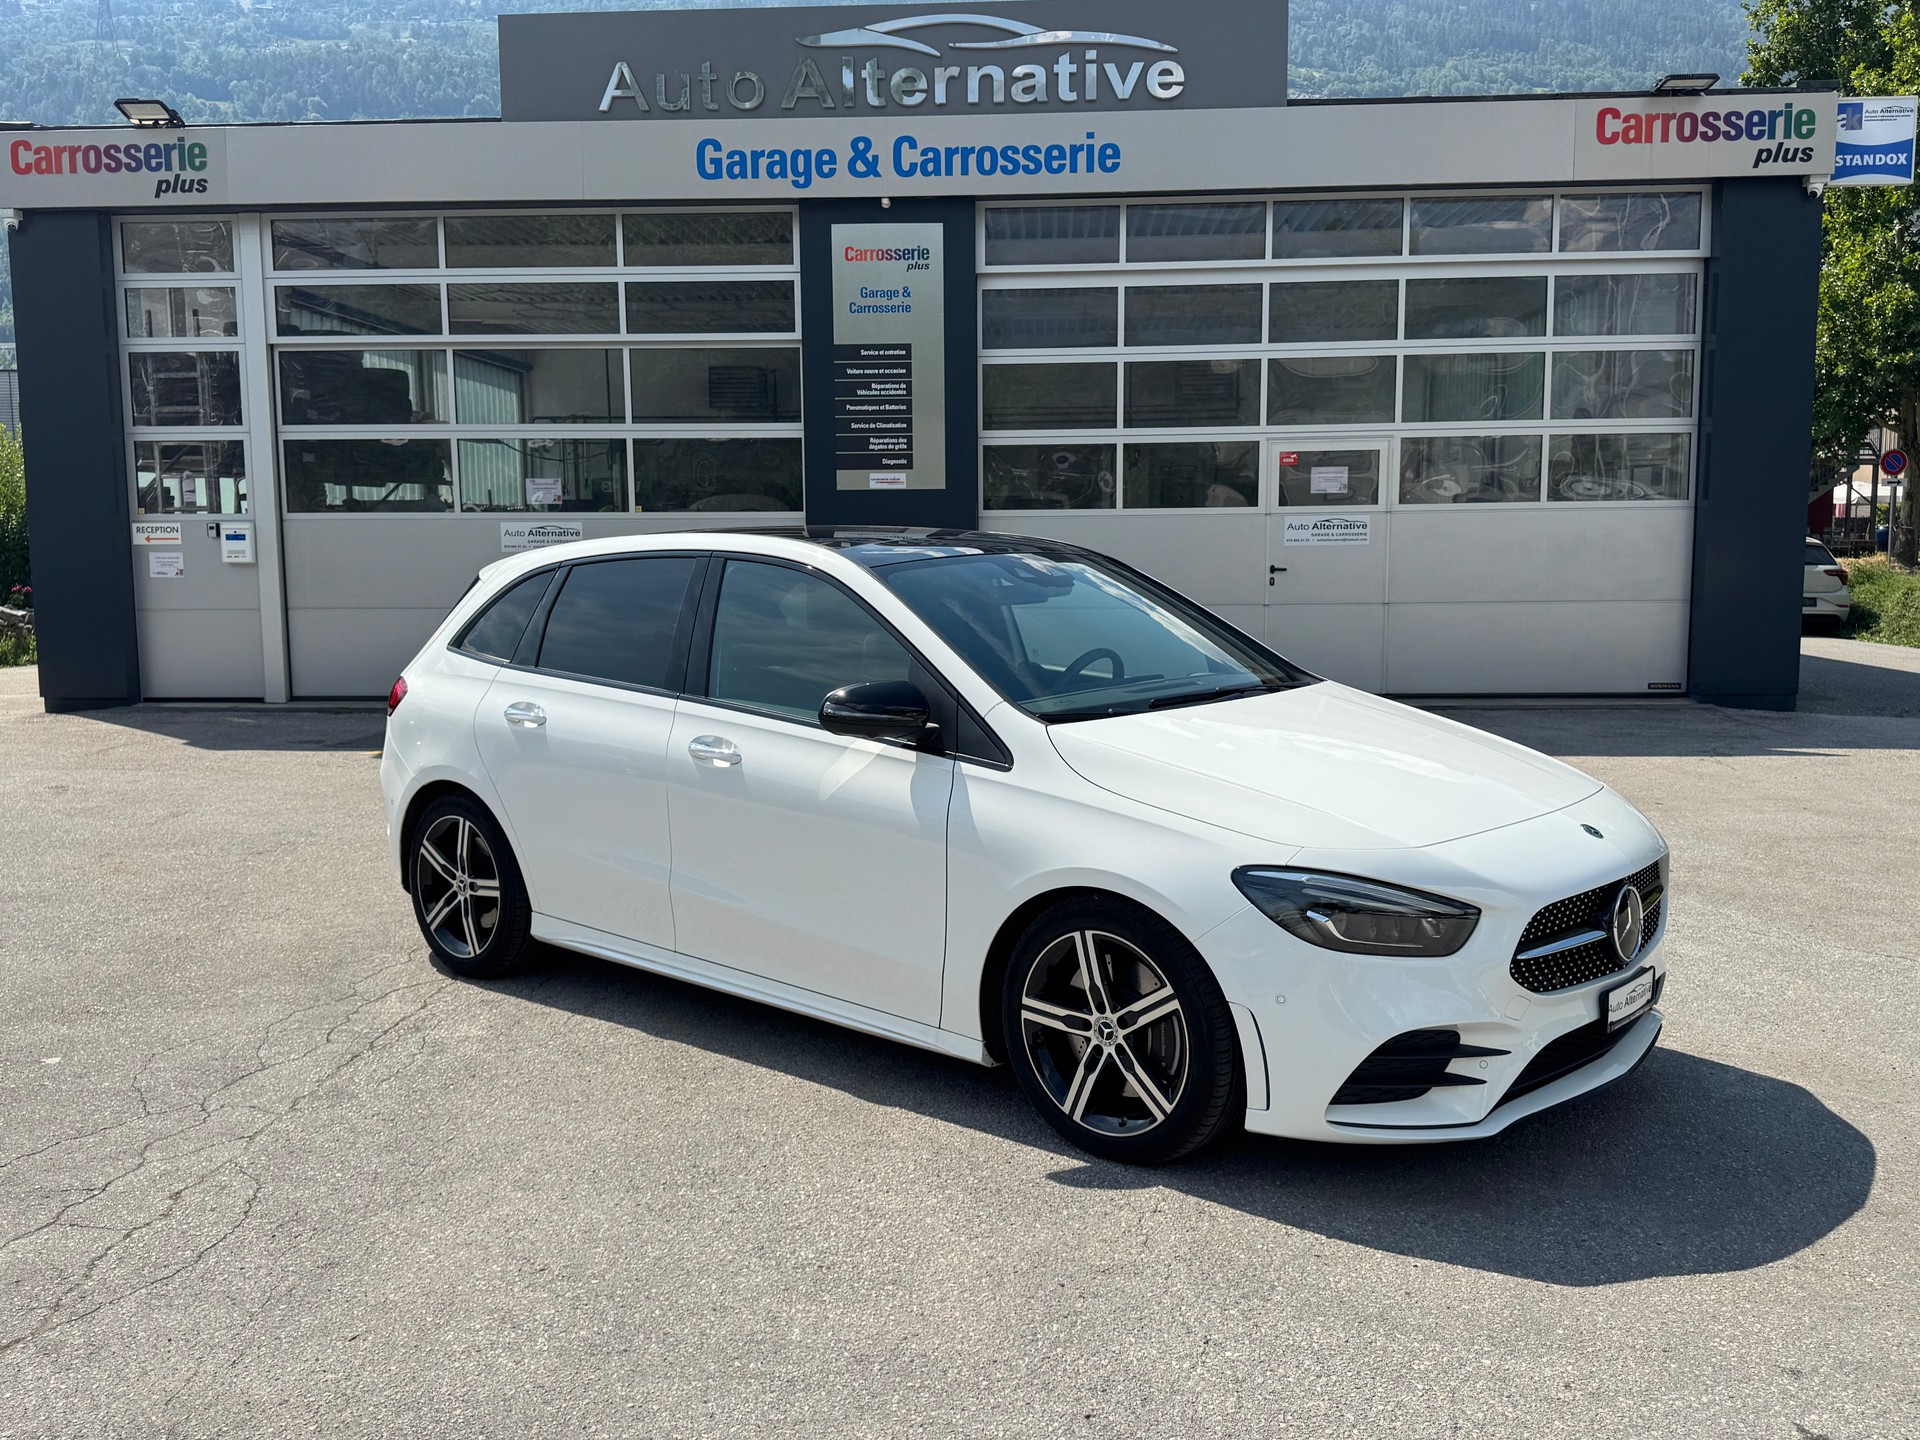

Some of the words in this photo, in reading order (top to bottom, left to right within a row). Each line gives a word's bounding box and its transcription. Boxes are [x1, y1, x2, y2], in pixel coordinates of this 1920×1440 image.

[598, 61, 766, 111] Auto
[780, 49, 1186, 109] Alternative
[1596, 103, 1816, 145] Carrosserie
[10, 136, 208, 175] Carrosserie
[696, 138, 838, 189] Garage
[847, 135, 883, 178] &
[892, 132, 1121, 178] Carrosserie
[1752, 142, 1814, 169] plus
[1835, 153, 1908, 167] STANDOX
[154, 173, 208, 199] plus
[845, 245, 930, 261] Carrosserie
[906, 261, 930, 272] plus
[860, 286, 900, 301] Garage
[902, 286, 912, 298] &
[849, 301, 912, 314] Carrosserie
[846, 404, 879, 412] Pneumatiques
[882, 458, 908, 466] Diagnostic
[136, 526, 179, 534] RECEPTION
[504, 529, 525, 537] Auto
[528, 529, 580, 537] Alternative
[1312, 522, 1368, 530] Alternative
[1609, 1001, 1624, 1014] Auto
[1624, 984, 1652, 1008] Alternative
